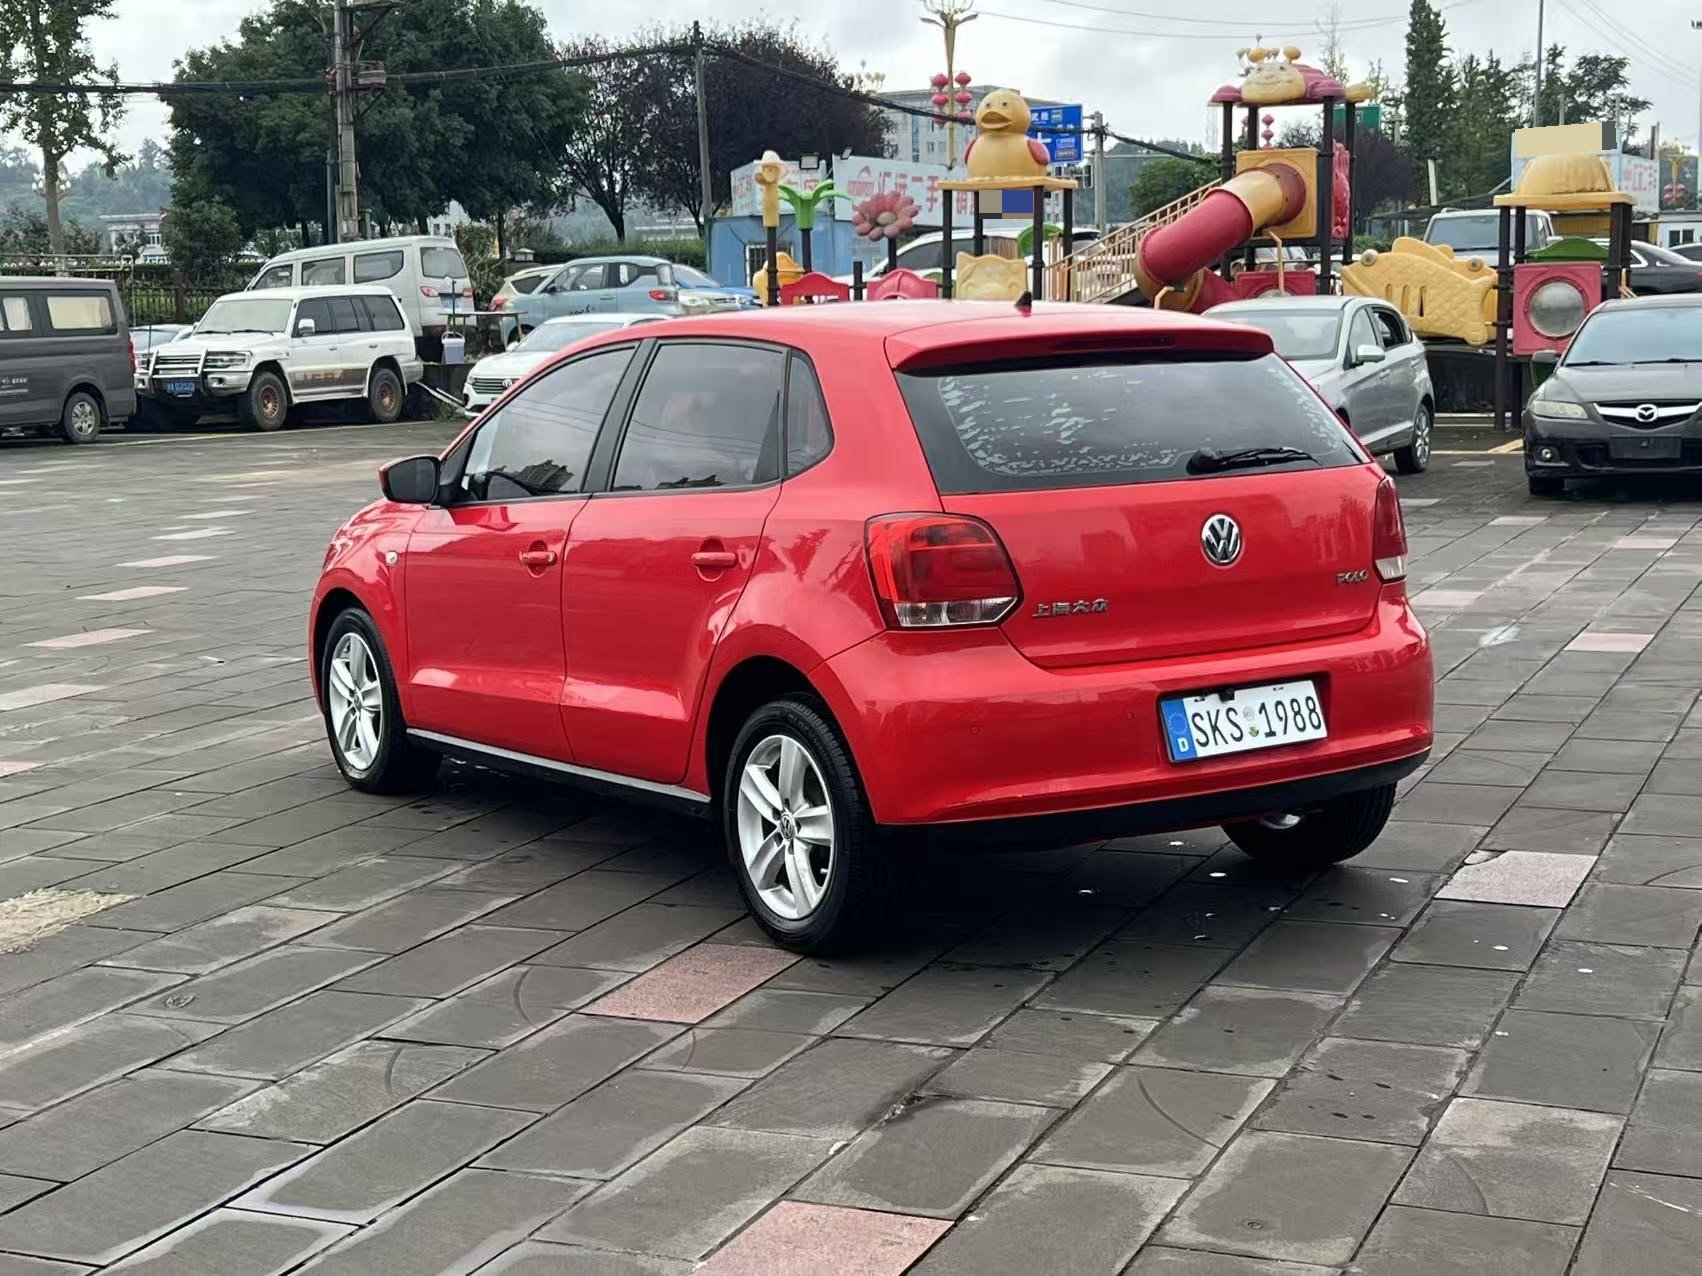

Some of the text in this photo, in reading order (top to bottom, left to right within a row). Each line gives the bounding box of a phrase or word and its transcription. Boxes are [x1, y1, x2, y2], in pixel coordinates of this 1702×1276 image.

[1032, 598, 1109, 618] 上海大众
[1191, 696, 1322, 748] SKS 1988
[1177, 737, 1190, 753] D
